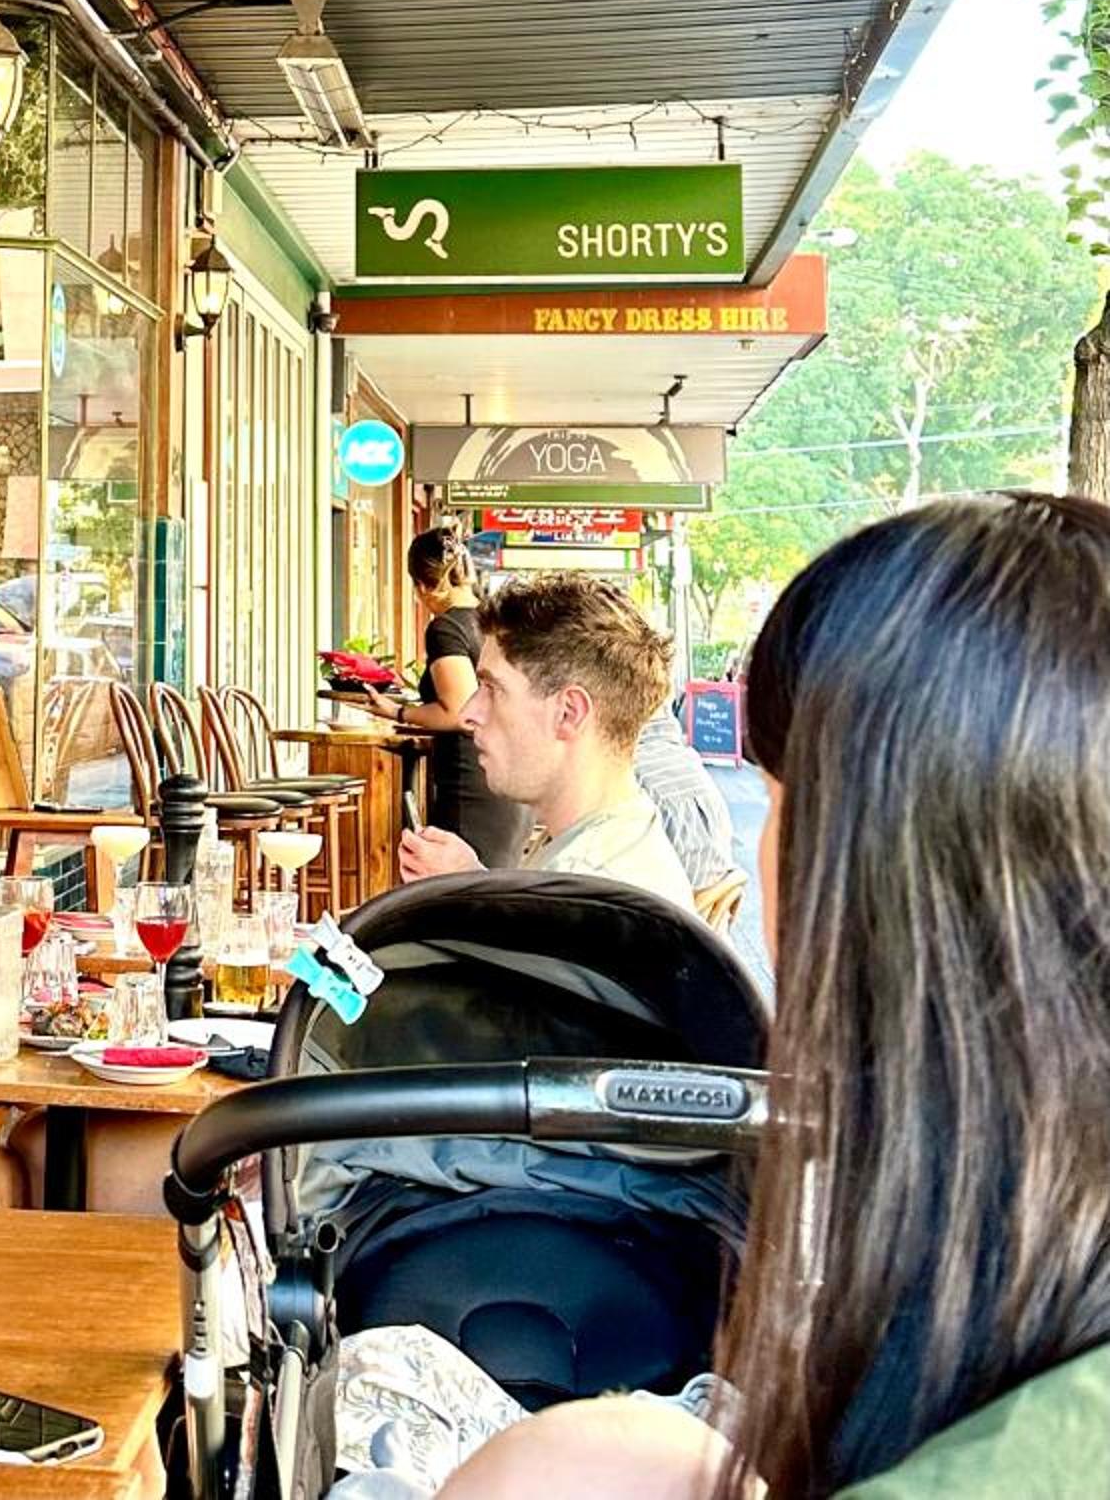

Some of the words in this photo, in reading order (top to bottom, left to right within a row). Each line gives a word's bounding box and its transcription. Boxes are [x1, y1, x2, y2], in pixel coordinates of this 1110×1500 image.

[557, 222, 729, 258] SHORTY'S
[534, 306, 617, 332] FANCY
[625, 306, 712, 332] DRESS
[720, 306, 788, 332] HIRE
[529, 442, 606, 474] YOGA
